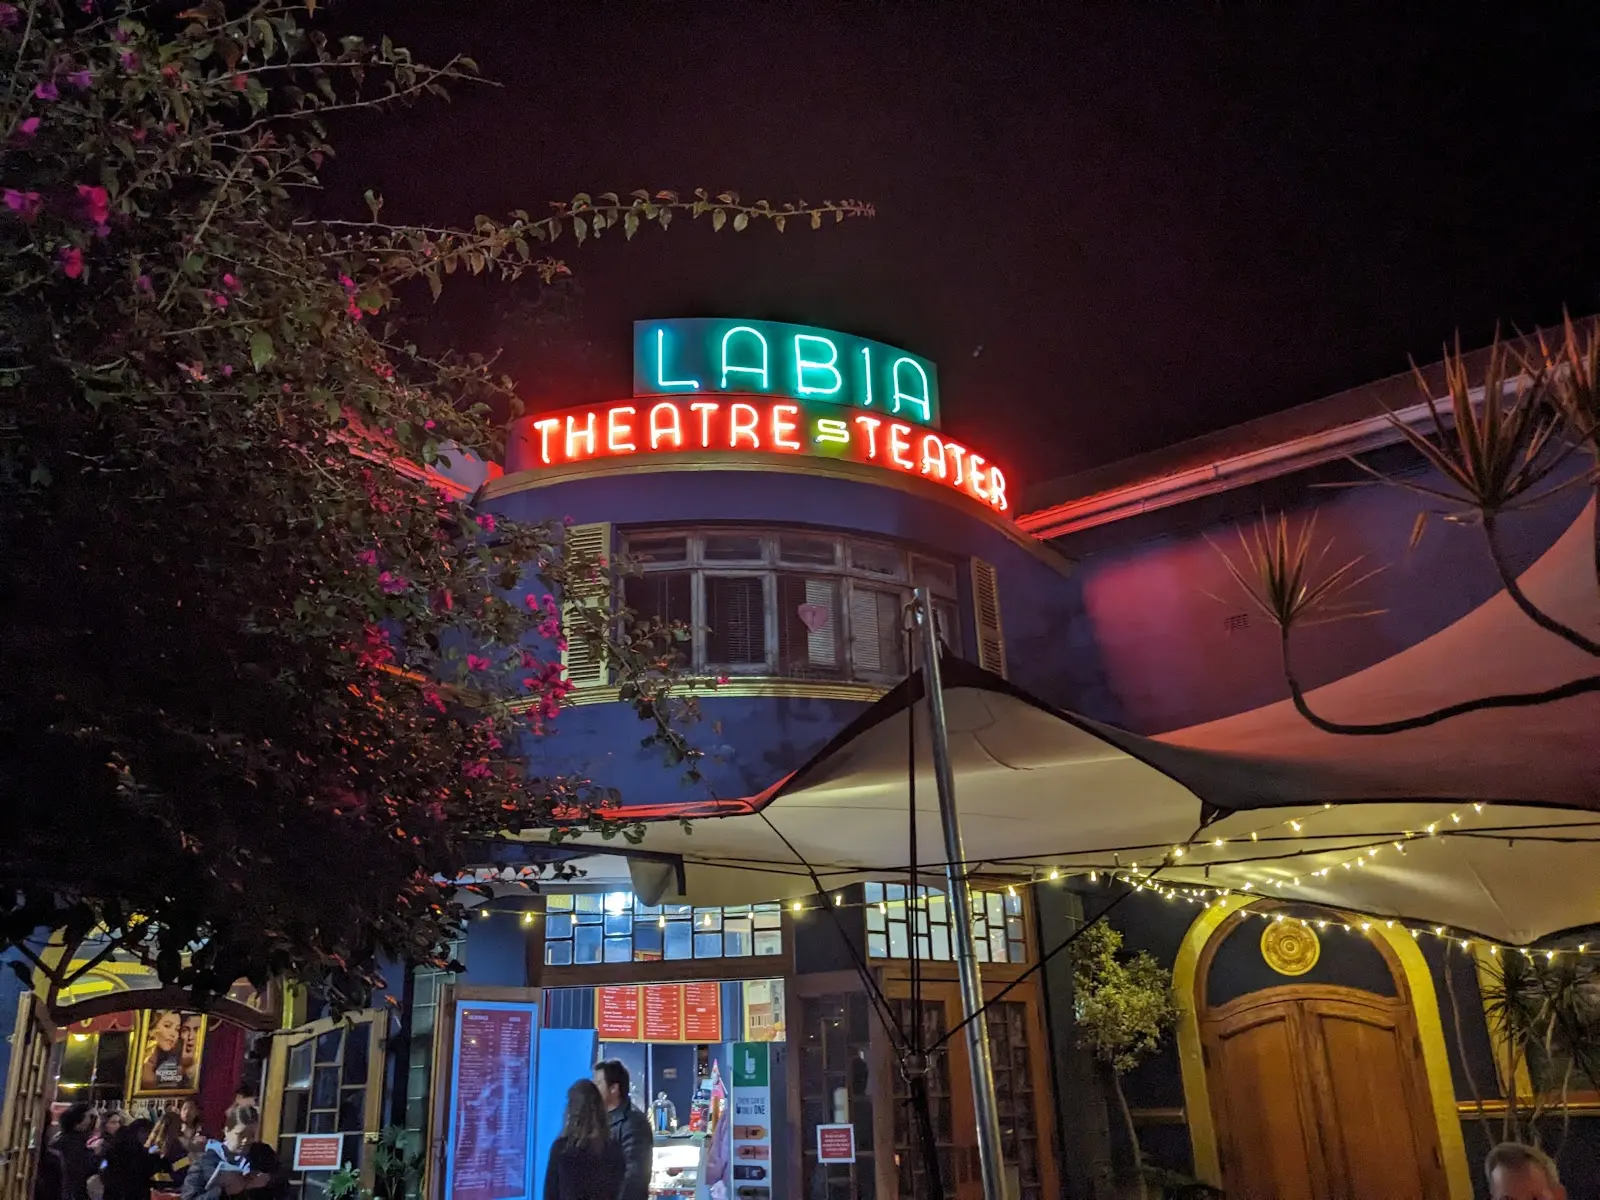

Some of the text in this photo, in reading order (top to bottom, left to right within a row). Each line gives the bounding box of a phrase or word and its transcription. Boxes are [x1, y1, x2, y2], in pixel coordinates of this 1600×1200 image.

[656, 325, 931, 421] LABIA
[533, 402, 801, 464] THEATRE
[855, 415, 1009, 511] TEATER
[753, 1105, 766, 1115] ONE
